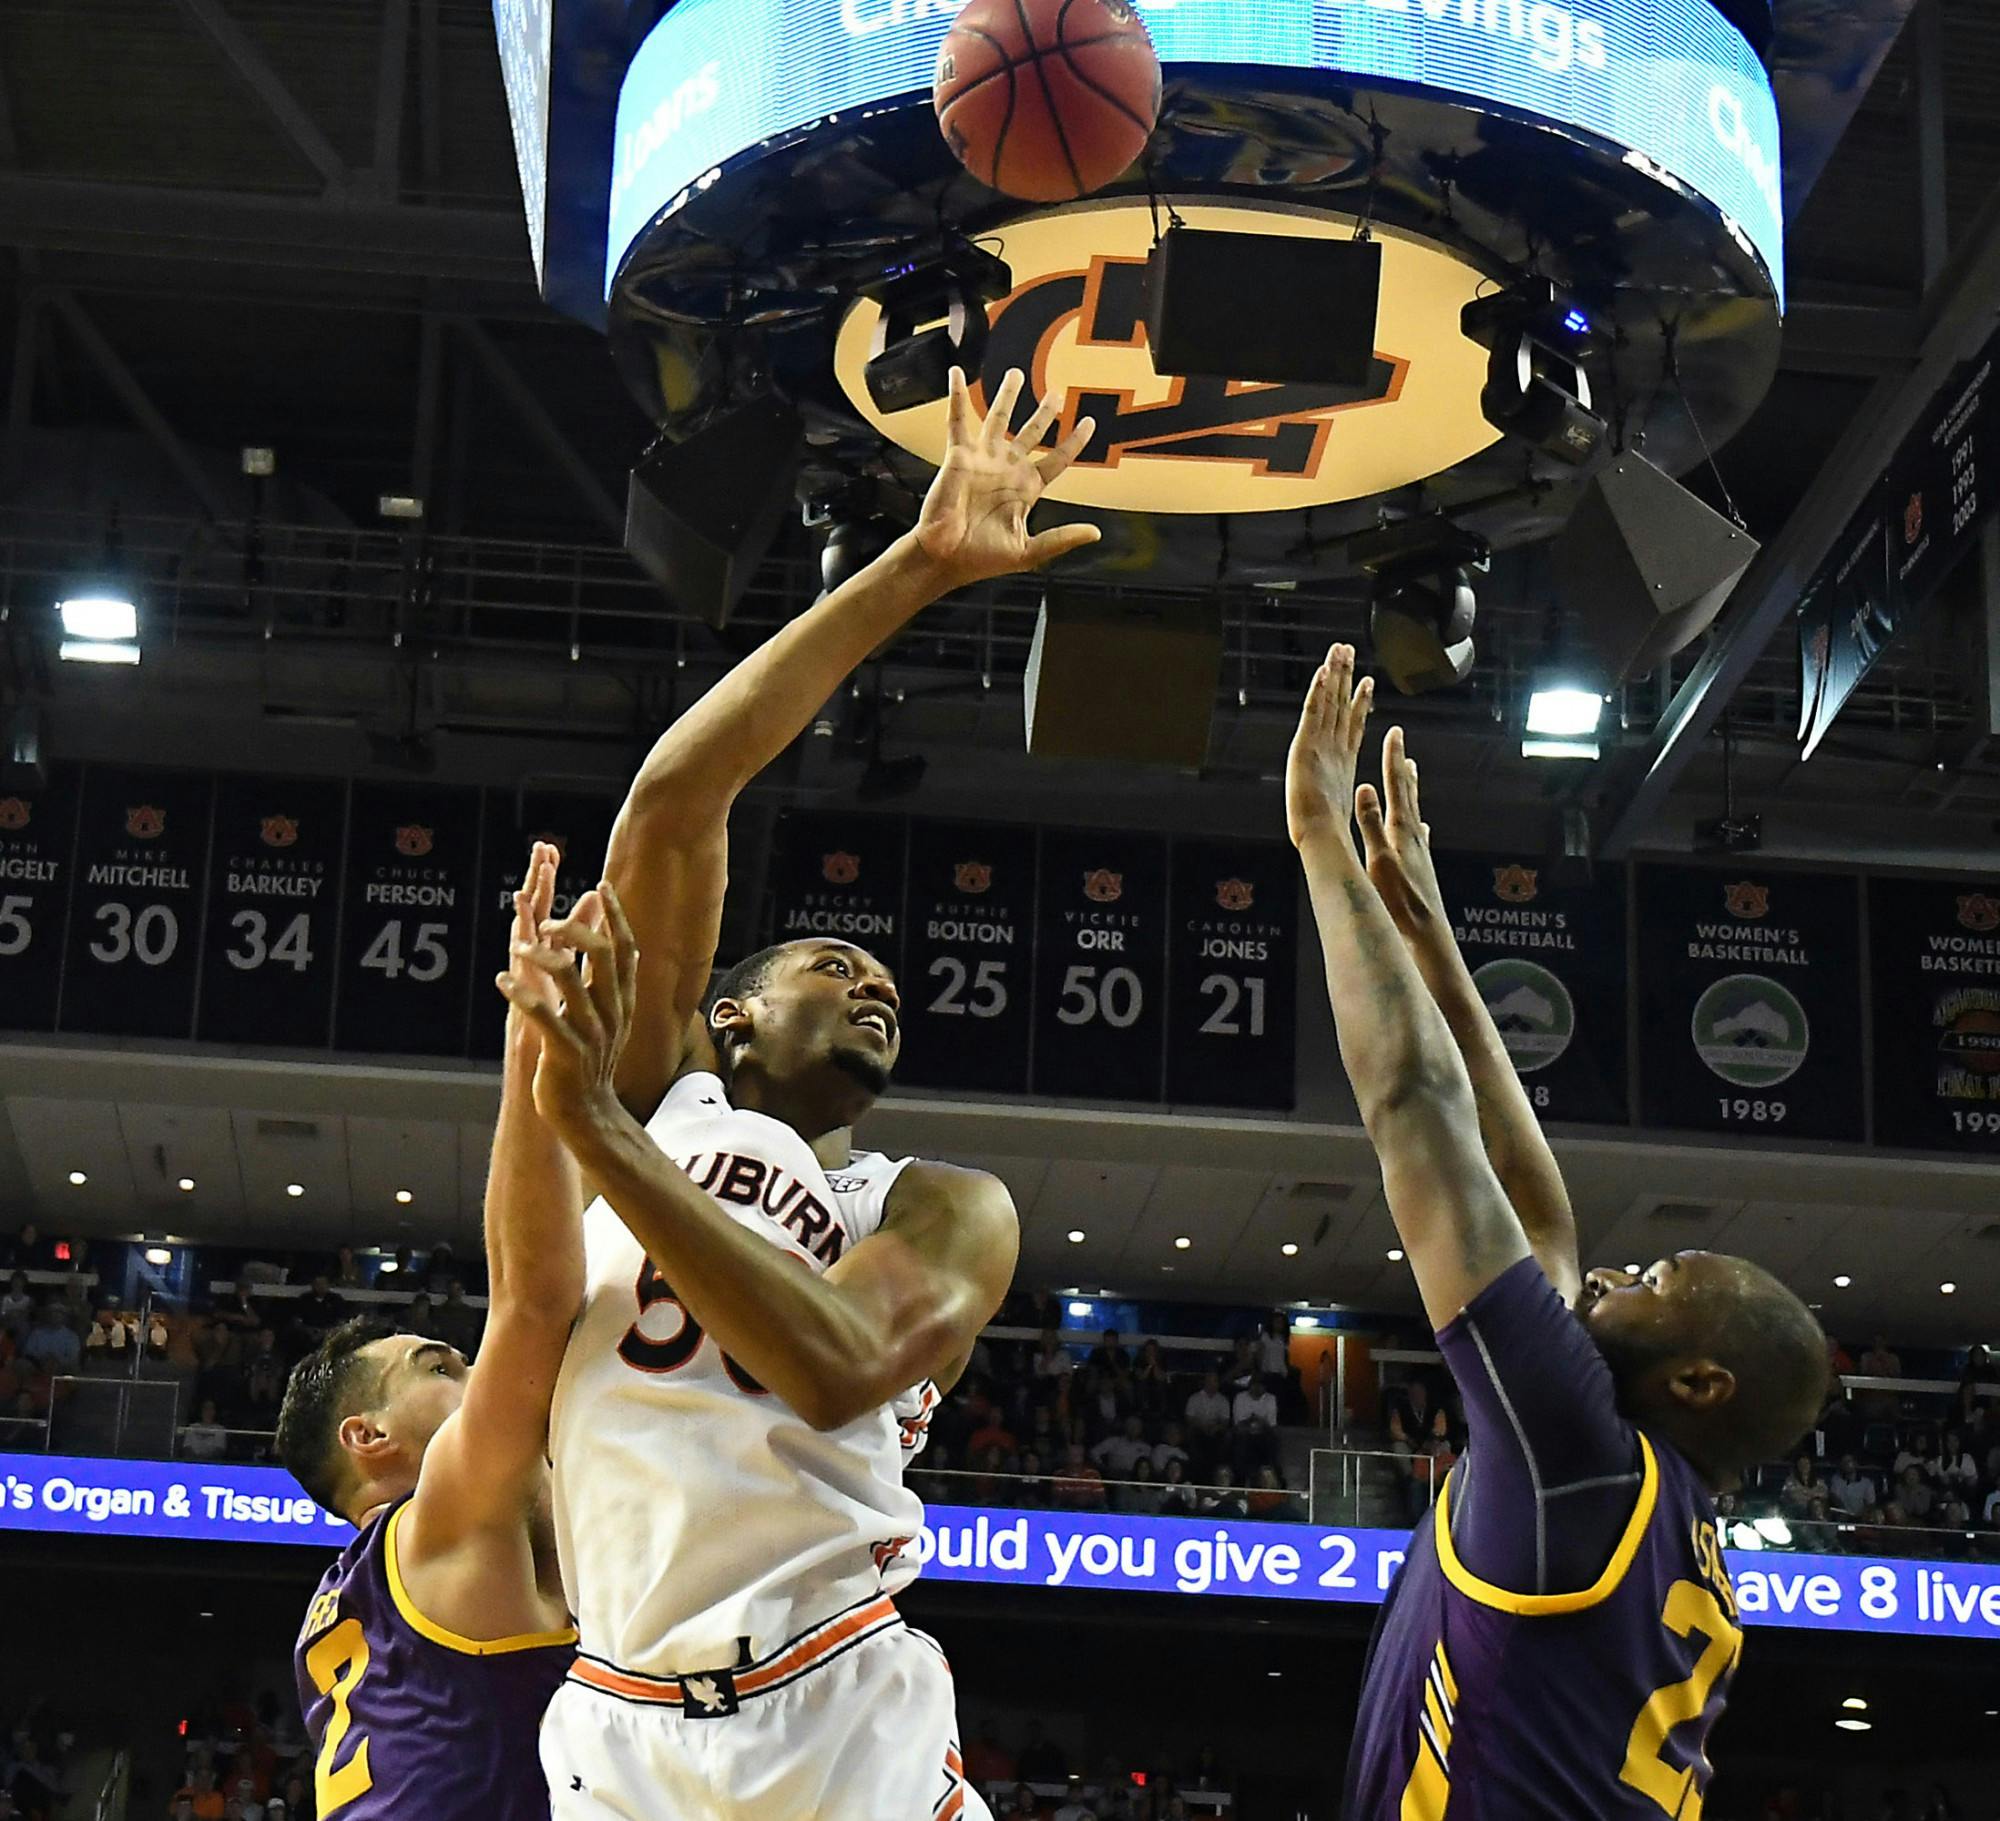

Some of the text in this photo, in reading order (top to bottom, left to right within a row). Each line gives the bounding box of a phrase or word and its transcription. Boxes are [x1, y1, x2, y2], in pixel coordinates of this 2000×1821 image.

[116, 849, 168, 862] MIKE
[229, 856, 325, 874] CHARLES
[0, 858, 59, 881] GELT
[88, 864, 190, 889] MITCHELL
[376, 866, 449, 882] CHUCK
[226, 873, 323, 898] BARKLEY
[366, 883, 456, 907] PERSON
[804, 893, 873, 908] BECKY
[784, 908, 893, 935] JACKSON
[1064, 911, 1140, 928] VICKIE
[1186, 919, 1282, 937] CAROLYN
[1463, 907, 1567, 929] WOMEN'S
[89, 902, 179, 966] 30
[226, 910, 314, 972] 34
[927, 919, 1014, 945] BOLTON
[1076, 928, 1125, 952] ORR
[1455, 927, 1576, 951] BASKETBALL
[1695, 923, 1800, 945] WOMEN'S
[359, 919, 450, 982] 45
[1198, 937, 1268, 961] JONES
[1687, 941, 1810, 966] BASKETBALL
[926, 956, 1009, 1018] 25
[1056, 964, 1144, 1028] 50
[1198, 973, 1265, 1036] 21
[1718, 1097, 1787, 1122] 1989
[676, 1151, 850, 1267] UBURN
[42, 1477, 154, 1522] Organ
[162, 1484, 191, 1518] &
[200, 1485, 317, 1525] Tissue
[1044, 1532, 1156, 1586] you
[1173, 1529, 1301, 1593] give
[1317, 1535, 1357, 1588] 2
[1728, 1570, 1841, 1616] ave
[1859, 1565, 1898, 1619] 8
